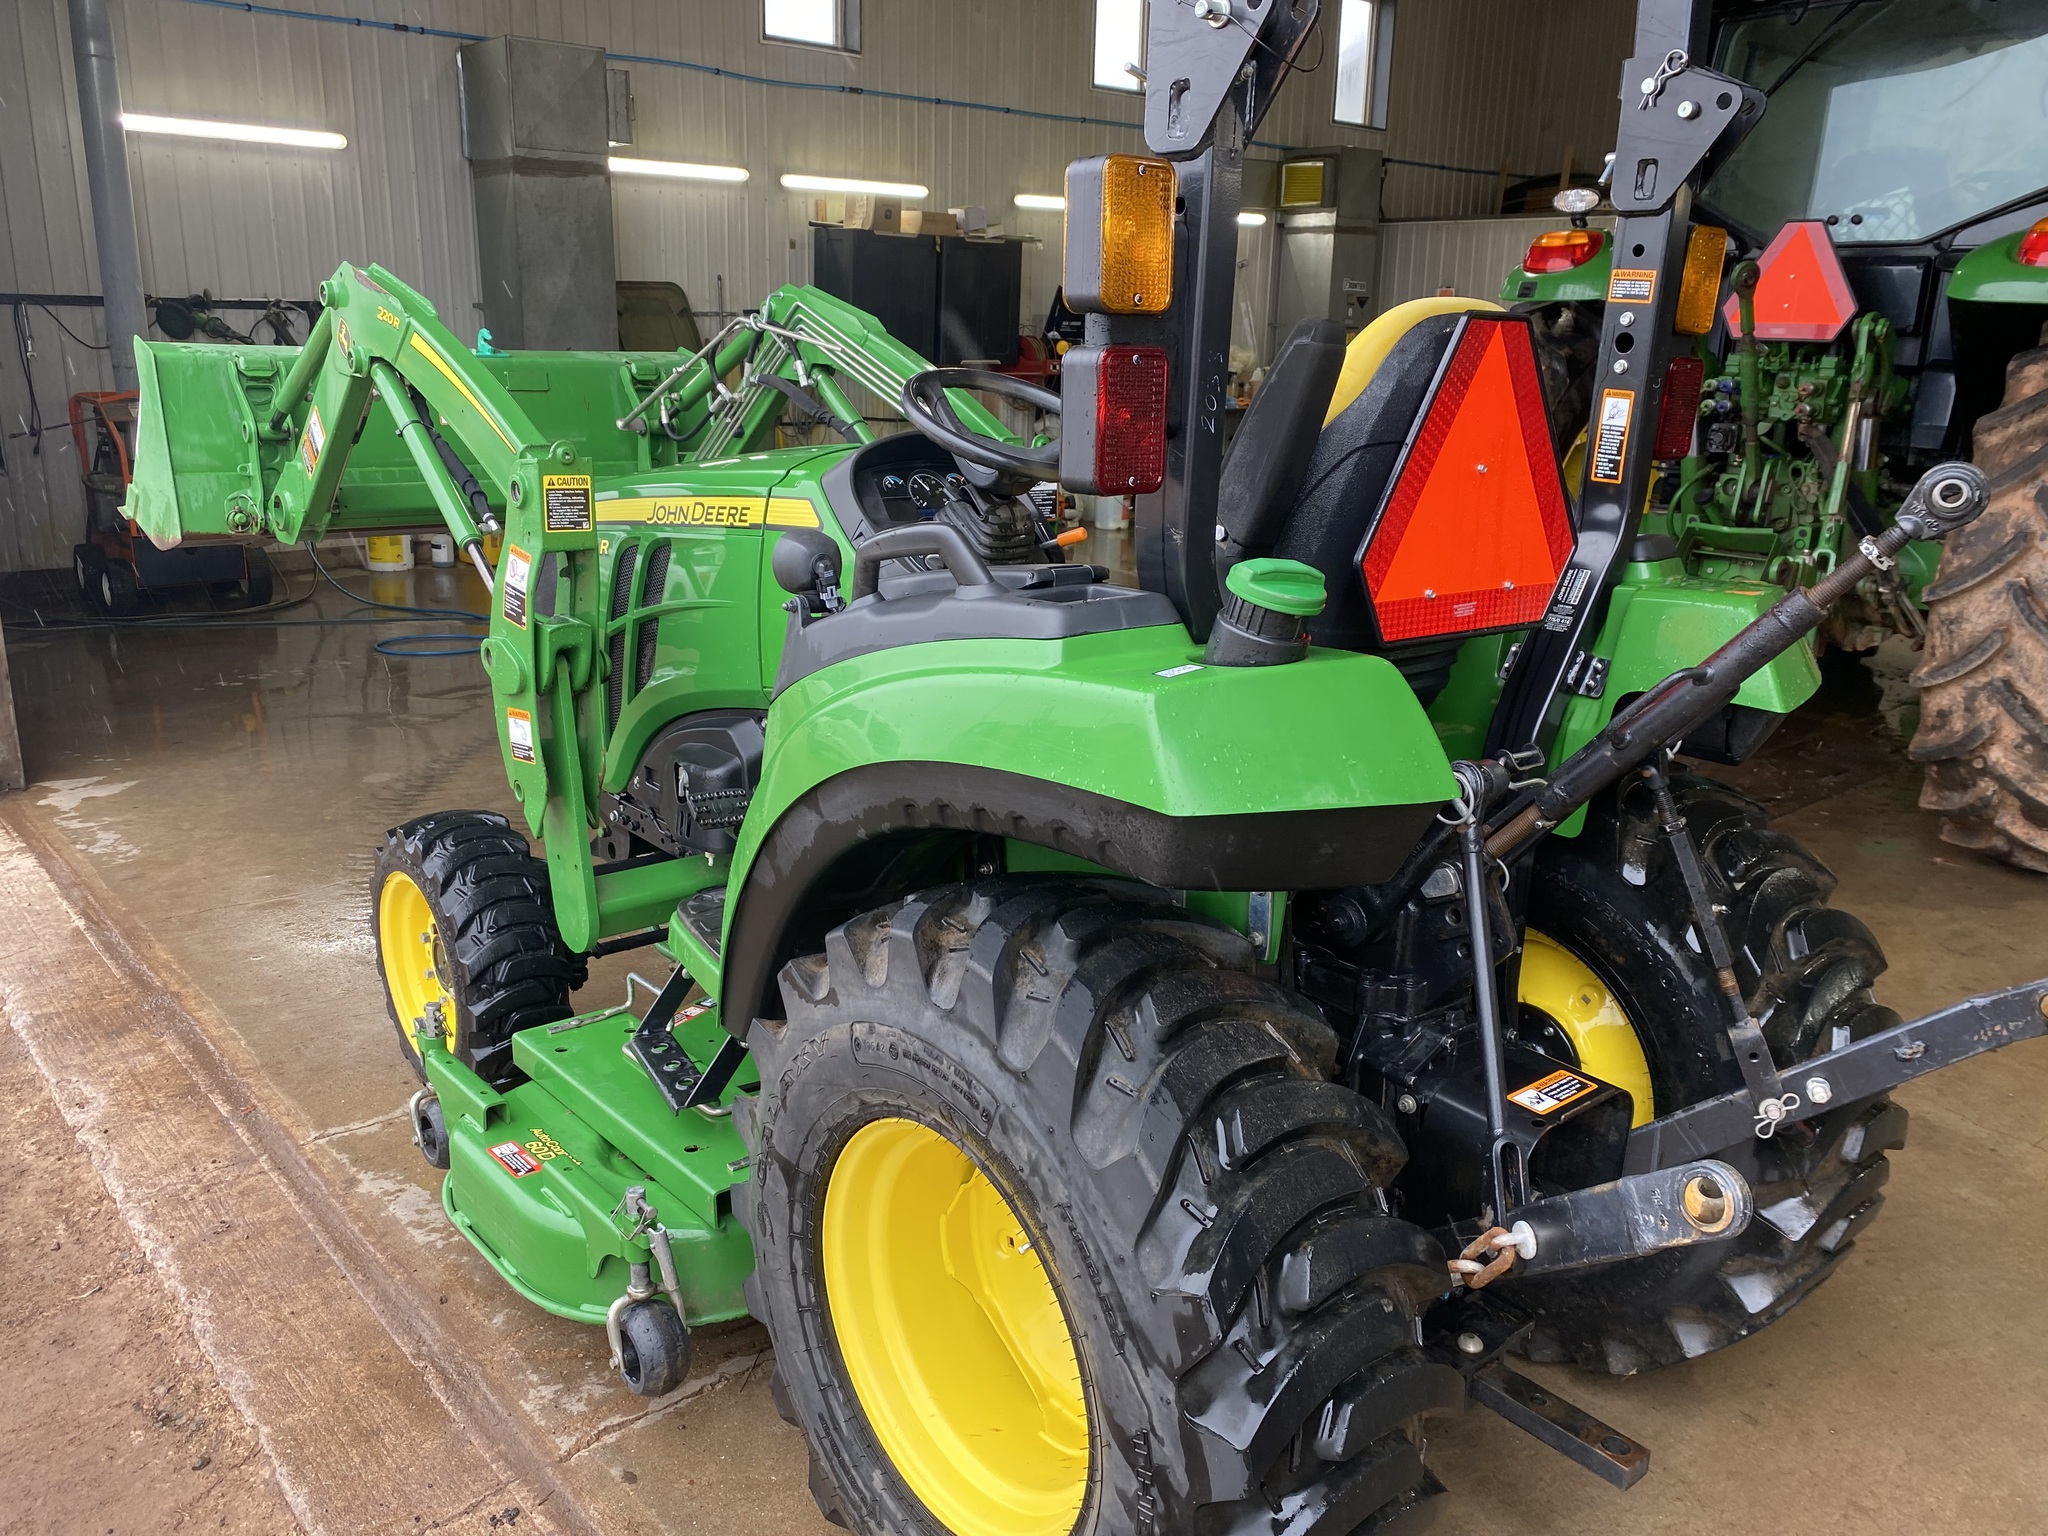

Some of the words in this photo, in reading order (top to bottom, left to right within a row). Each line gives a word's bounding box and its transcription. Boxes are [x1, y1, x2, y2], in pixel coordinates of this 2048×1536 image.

[1620, 271, 1654, 279] WARNING
[376, 305, 400, 330] 220R
[556, 477, 589, 487] CAUTION
[646, 502, 690, 522] JOHN
[691, 501, 751, 523] DEERE
[756, 1031, 829, 1189] GALAXY
[524, 1141, 557, 1161] 60D
[528, 1127, 582, 1166] AutoCon
[1059, 1202, 1127, 1354] TUBELESS
